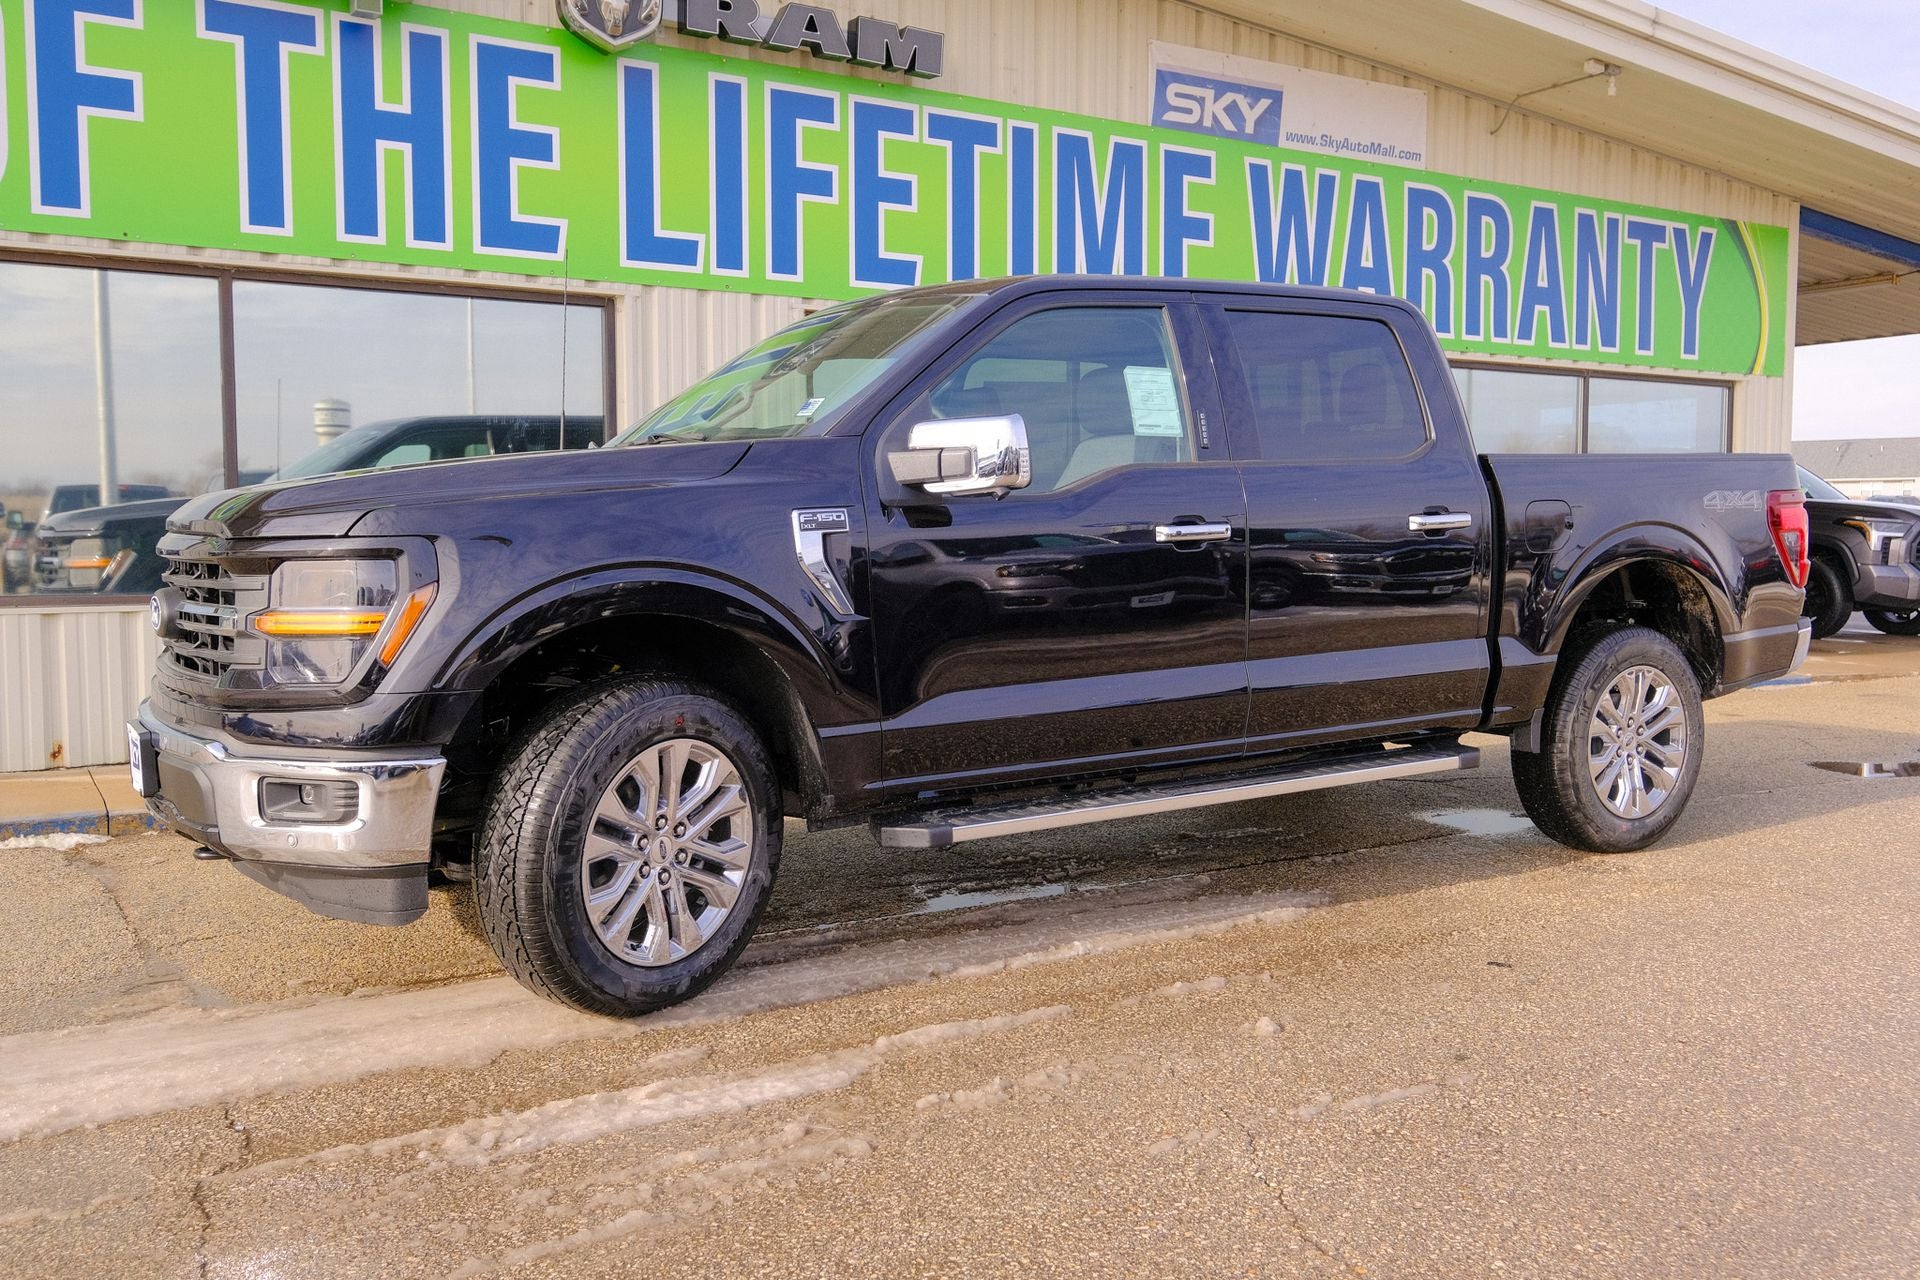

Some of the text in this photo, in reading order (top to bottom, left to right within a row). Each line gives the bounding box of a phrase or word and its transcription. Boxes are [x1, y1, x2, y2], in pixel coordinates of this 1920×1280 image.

[679, 0, 944, 79] RAM
[1161, 82, 1273, 134] SKY
[1285, 130, 1421, 162] www.SkyAutoMall.com
[0, 0, 144, 219] F
[196, 0, 568, 261] THE
[1244, 156, 1717, 360] WARRANTY
[800, 512, 845, 523] F-150
